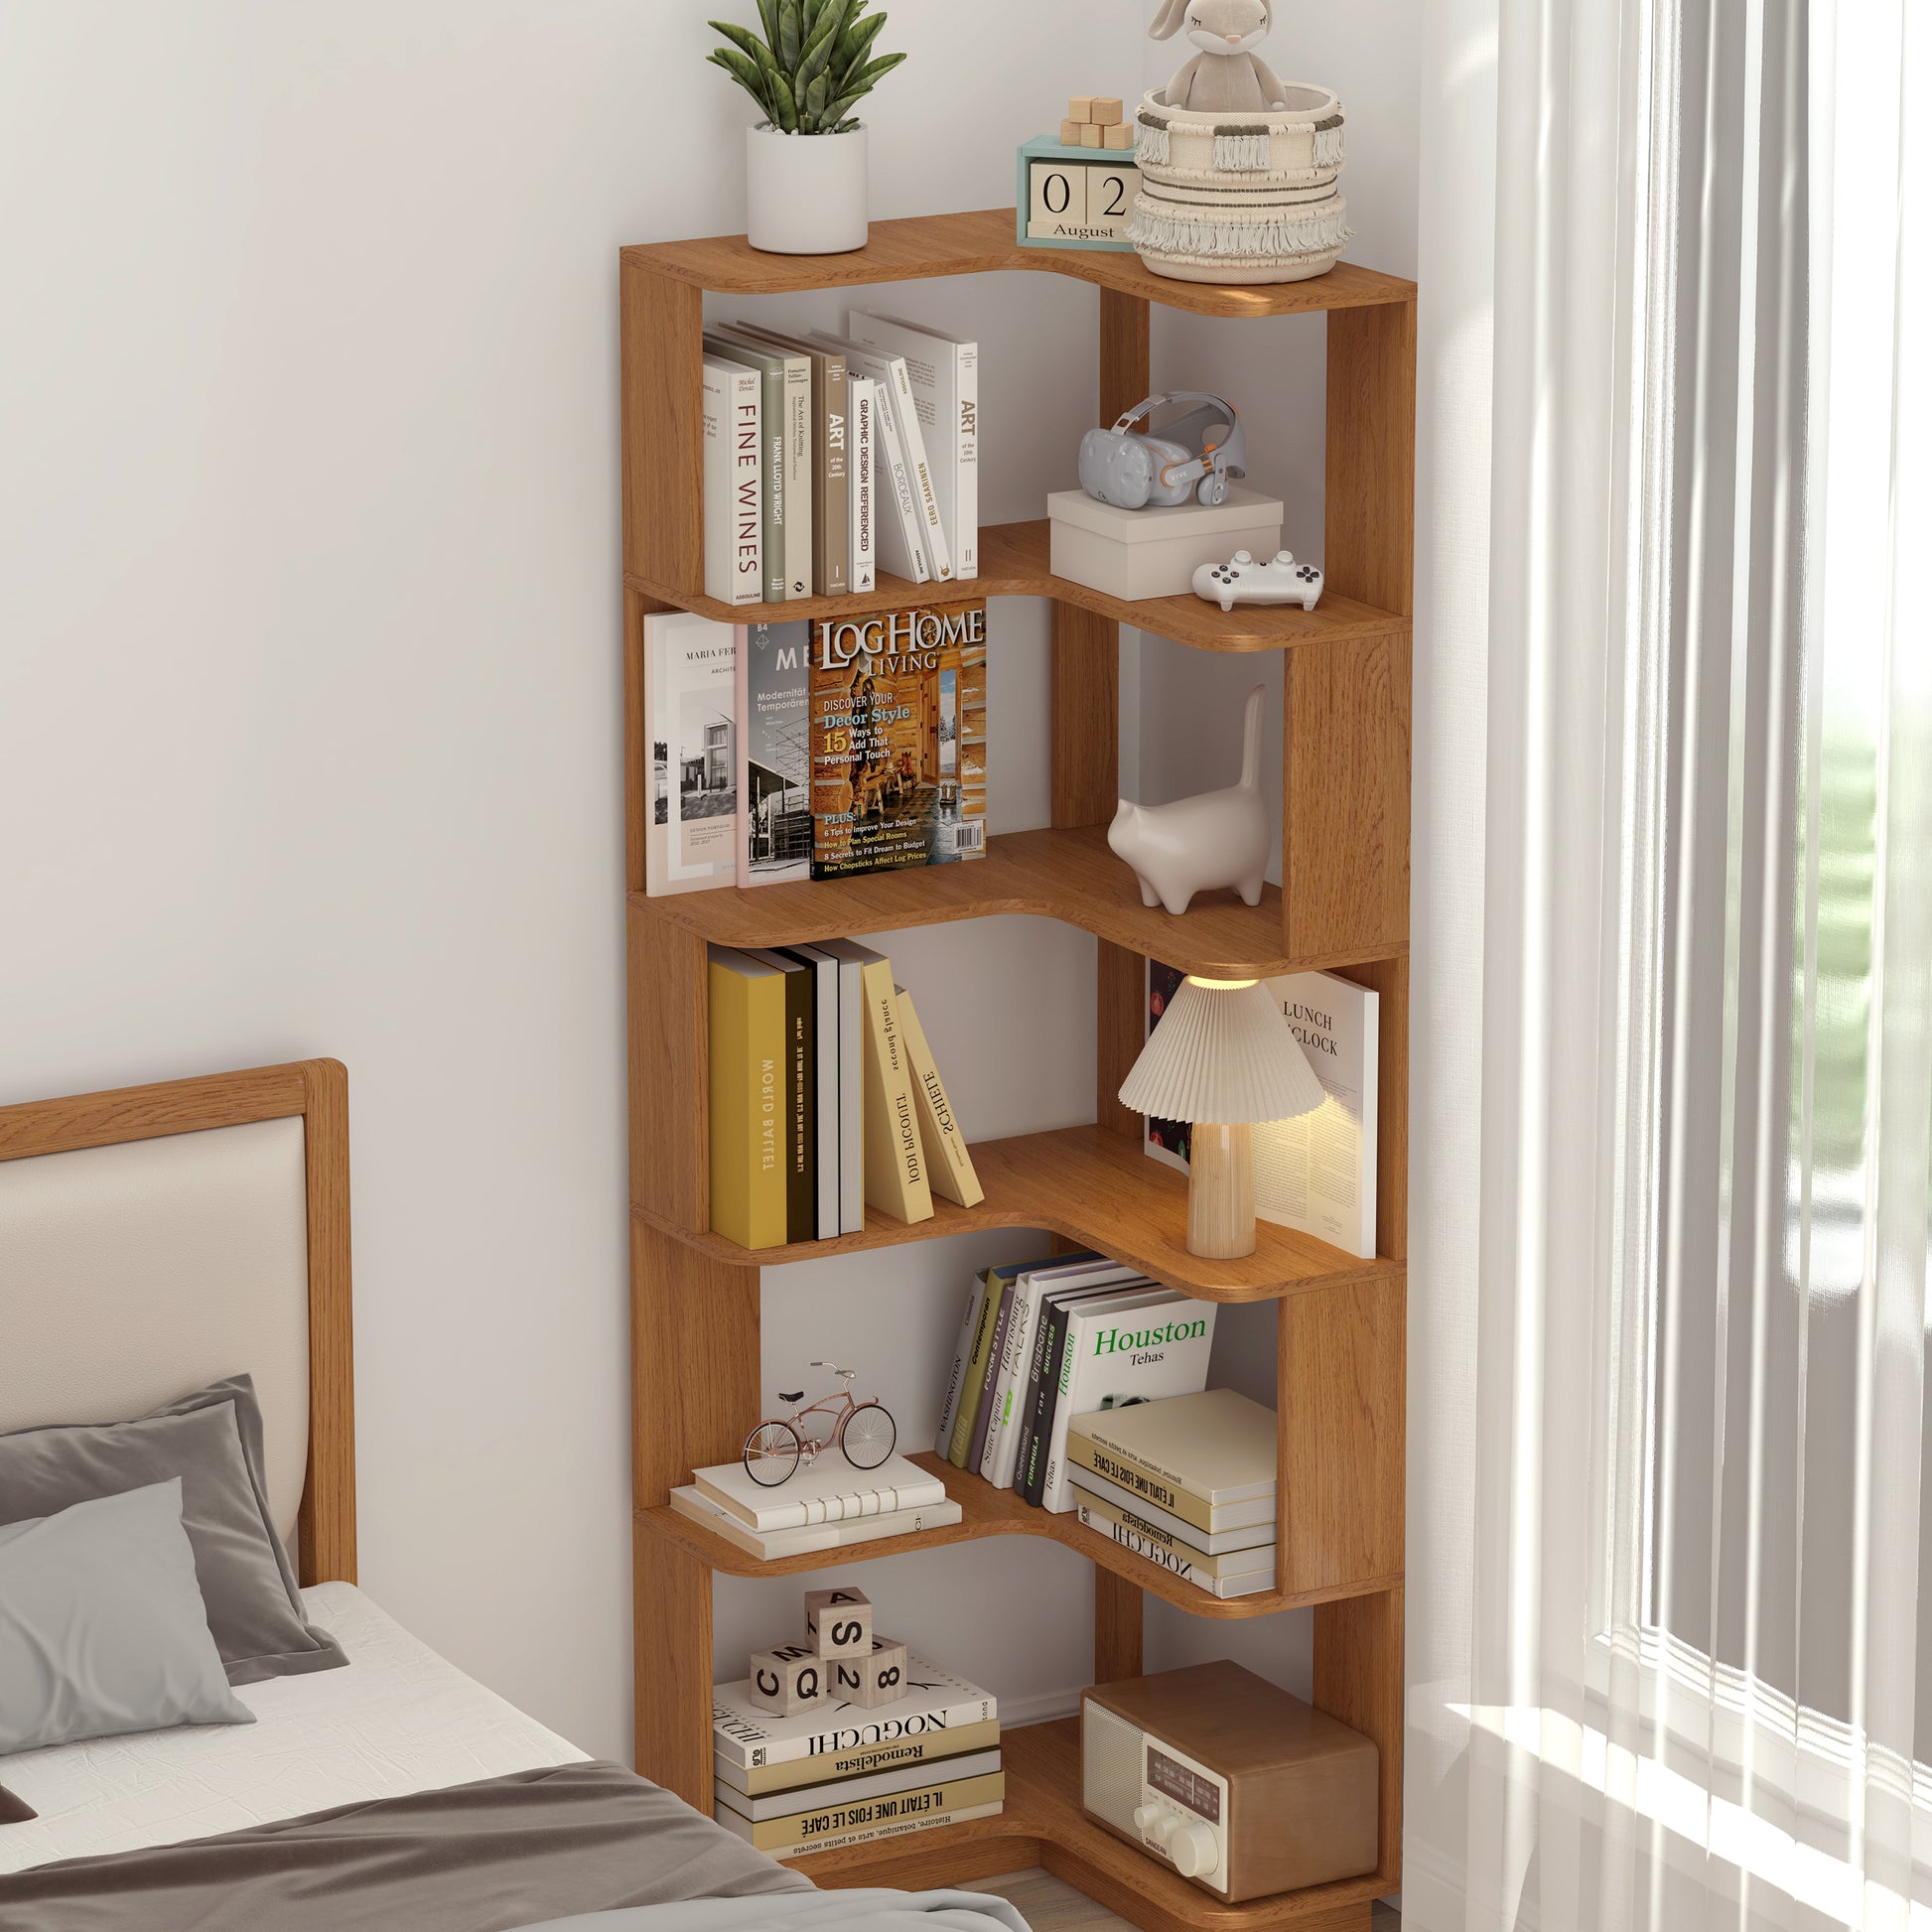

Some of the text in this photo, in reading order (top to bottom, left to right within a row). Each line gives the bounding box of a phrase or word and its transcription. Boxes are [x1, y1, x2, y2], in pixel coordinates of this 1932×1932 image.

[1053, 223, 1115, 239] August
[829, 413, 844, 451] ART
[860, 399, 869, 444] GRAPHIC
[961, 400, 976, 436] ART
[773, 437, 782, 525] FRANK LLOYD WRIGHT
[860, 447, 869, 483] DESIGN
[738, 404, 758, 573] FINE WINES
[894, 463, 913, 515] BORDEAUX
[917, 462, 938, 526] EERO SAARINEN
[860, 486, 869, 552] REFERENCED
[686, 649, 716, 660] MARIA
[868, 651, 938, 677] LIVING
[757, 687, 806, 702] Modernität
[823, 692, 894, 712] DISCOVER YOUR
[823, 705, 910, 730] Decor Style
[849, 726, 883, 739] Ways to
[823, 731, 847, 754] 15
[824, 748, 891, 765] Personal Touch
[849, 737, 888, 751] Add That
[824, 812, 857, 826] PLUS:
[830, 828, 844, 837] Tips
[853, 823, 879, 834] Improve
[880, 820, 894, 829] Your
[896, 818, 917, 827] Design
[830, 851, 855, 860] Secrets
[874, 845, 895, 854] Dream
[903, 840, 925, 850] Budget
[847, 837, 861, 846] Plan
[863, 834, 885, 844] Special
[886, 831, 907, 840] Rooms
[839, 859, 873, 871] Chopsticks
[874, 857, 894, 866] Affect
[907, 852, 927, 861] Prices
[1284, 1001, 1332, 1031] LUNCH
[1288, 1024, 1337, 1056] 'CLOCK
[1001, 1294, 1025, 1371] Harrisburg
[1031, 1314, 1048, 1383] Brisbane
[1092, 1319, 1206, 1356] Houston
[984, 1309, 1005, 1391] FORM STYLE
[1059, 1332, 1075, 1397] Houston
[1130, 1350, 1165, 1366] Tehas
[939, 1355, 962, 1433] WASHINGTON
[1002, 1389, 1013, 1426] TED
[1027, 1436, 1039, 1487] FORMULA
[1043, 1323, 1055, 1374] SUCCESS
[984, 1391, 1003, 1464] State Capital
[1017, 1426, 1030, 1480] Queensland
[830, 1591, 859, 1604] A
[831, 1621, 863, 1646] S
[757, 1669, 779, 1697] C
[796, 1668, 819, 1700] Q
[878, 1666, 900, 1689] 8
[808, 1709, 948, 1756] NOGUCHI
[835, 1744, 924, 1772] Remodelista
[801, 1791, 943, 1838] IL ÉTAIT UNE FOIS LE CAFÉ
[792, 1816, 951, 1855] Histoire, botanique, arts et petits secrets
